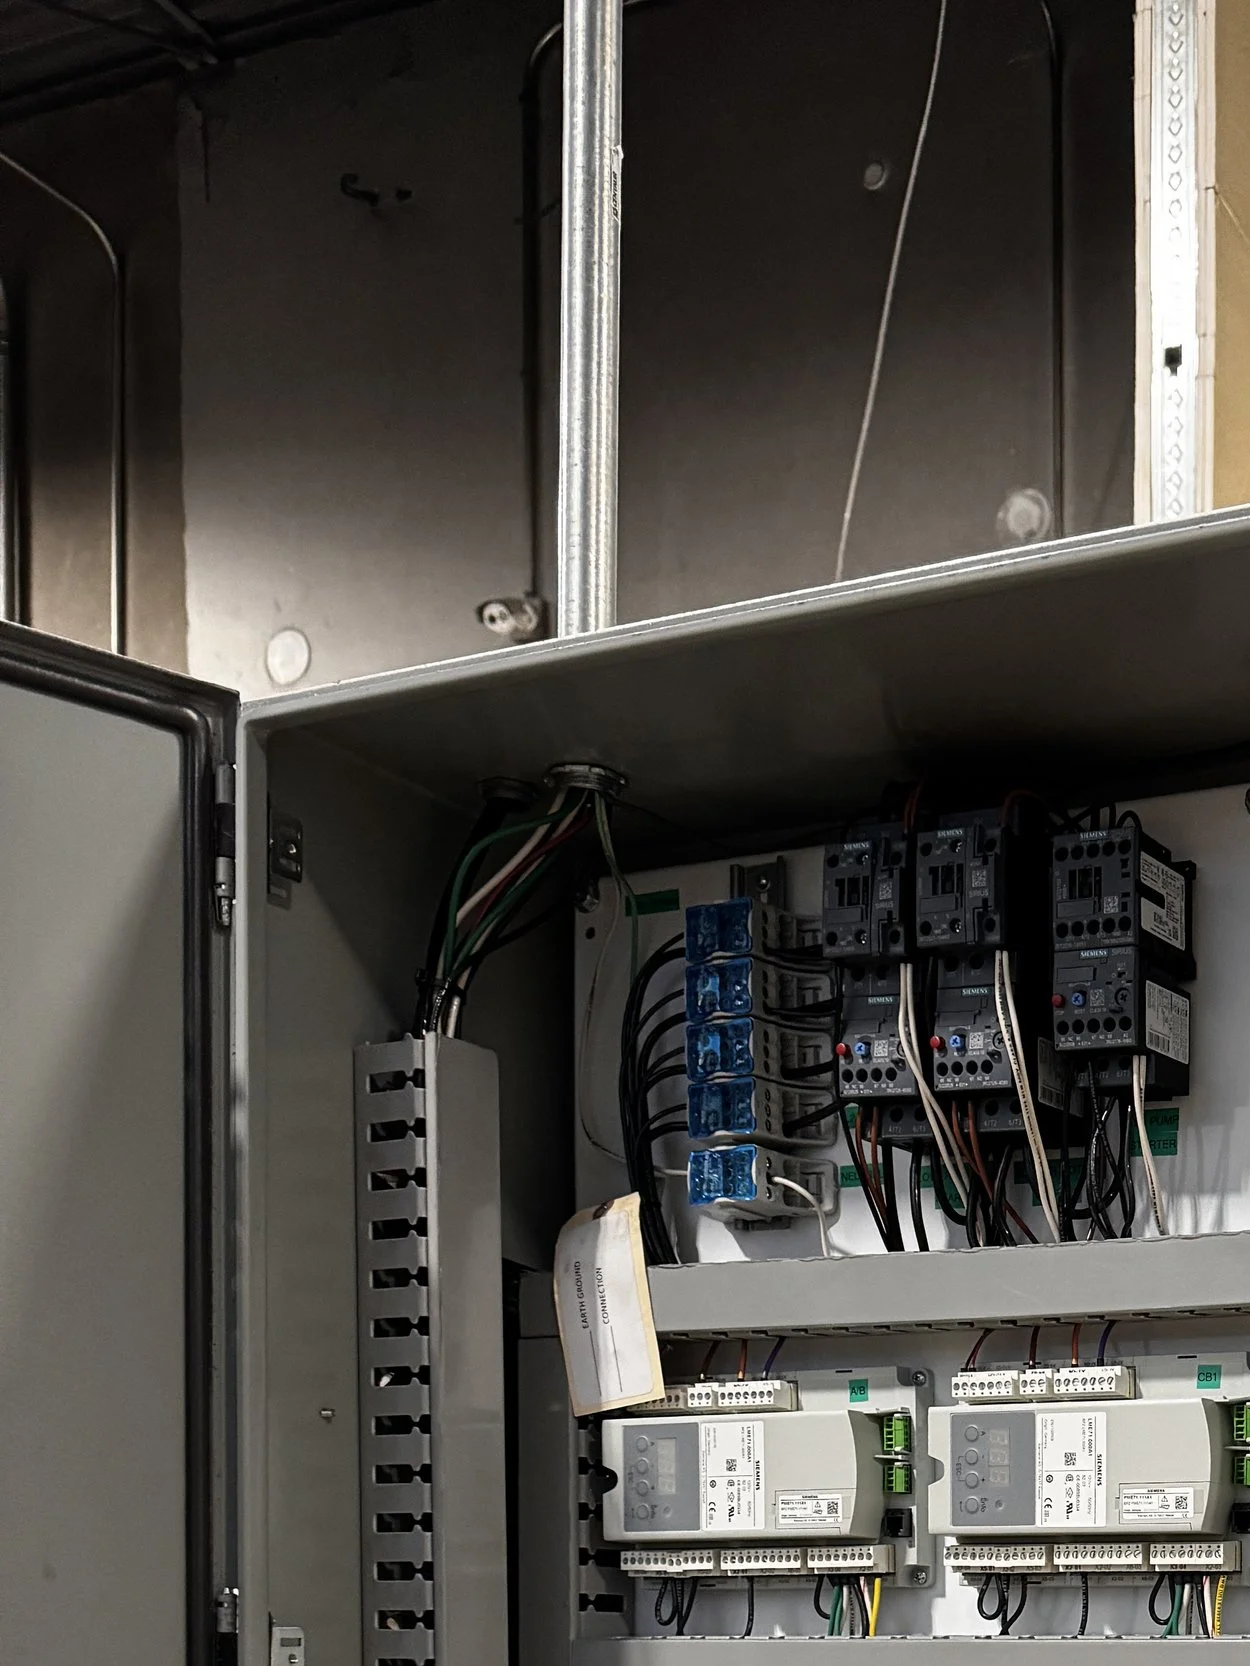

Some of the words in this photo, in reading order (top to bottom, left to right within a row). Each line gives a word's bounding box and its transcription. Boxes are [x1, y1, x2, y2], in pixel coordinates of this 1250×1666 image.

[1080, 831, 1107, 840] SIEMENS
[575, 1261, 585, 1299] GROUND
[596, 1267, 610, 1325] CONNECTION
[579, 1299, 589, 1329] EARTH
[1197, 1372, 1218, 1383] CB1
[849, 1385, 866, 1397] A/B
